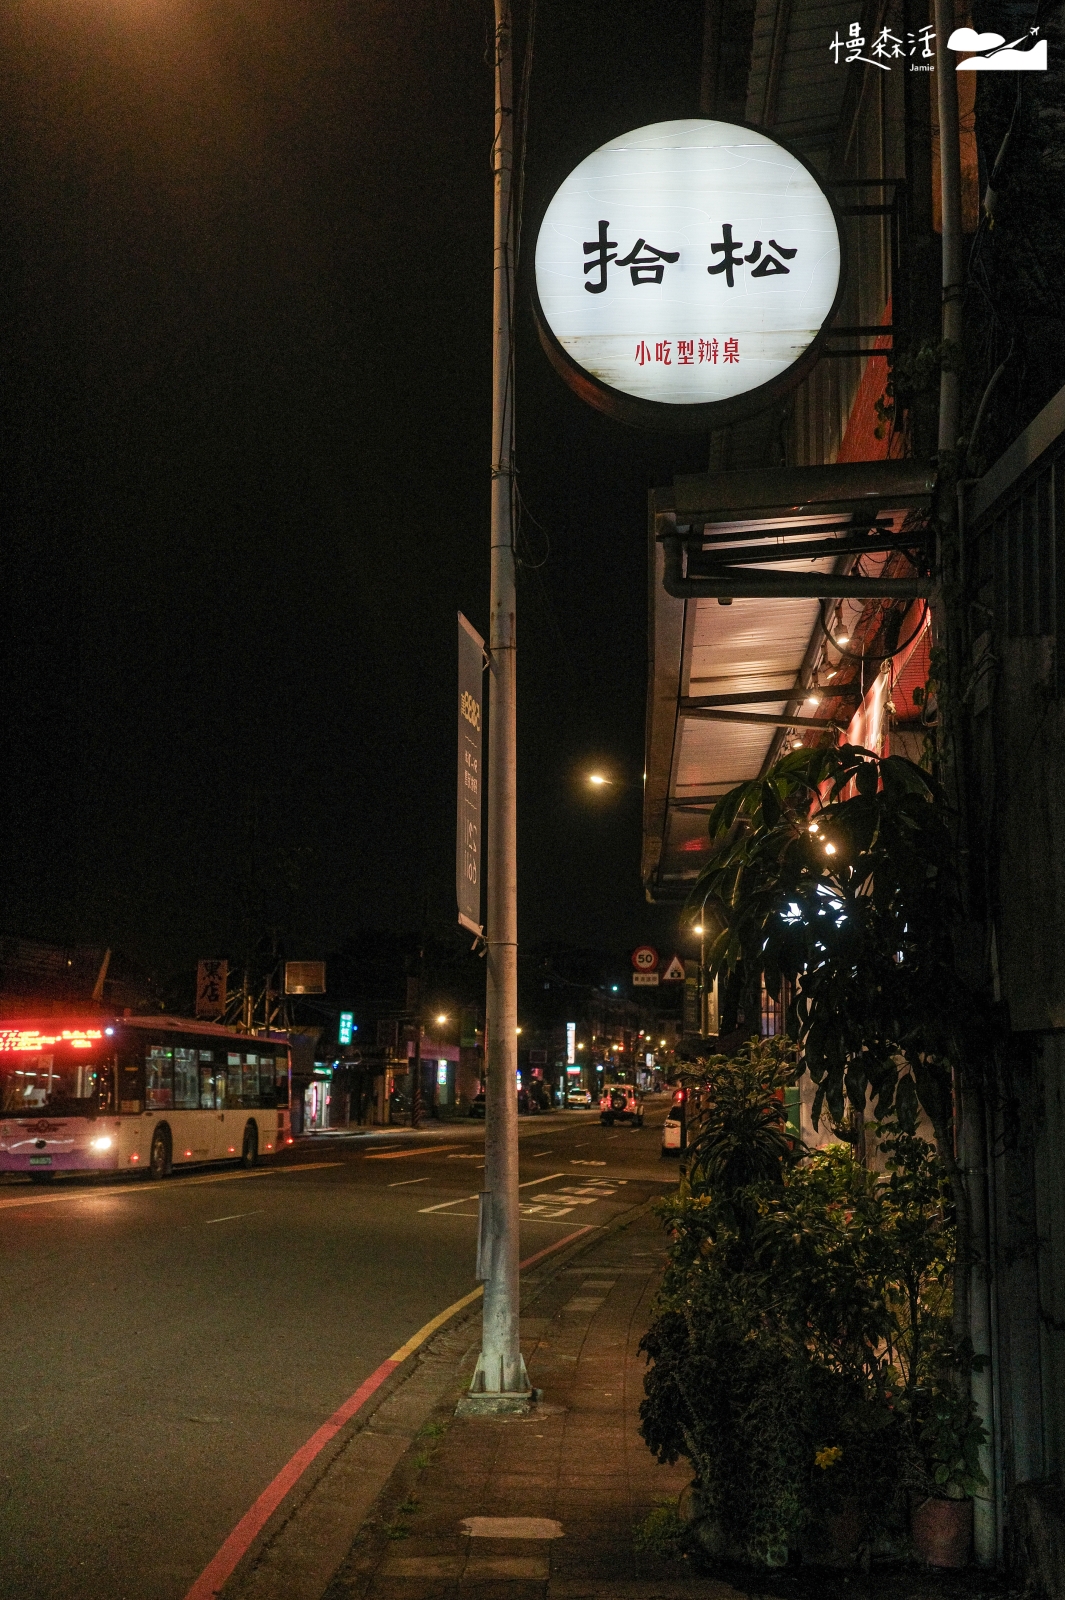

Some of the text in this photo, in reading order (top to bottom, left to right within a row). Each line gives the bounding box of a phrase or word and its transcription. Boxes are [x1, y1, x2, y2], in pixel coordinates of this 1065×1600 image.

[634, 336, 741, 366] 小吃型辦桌
[638, 954, 653, 963] 50
